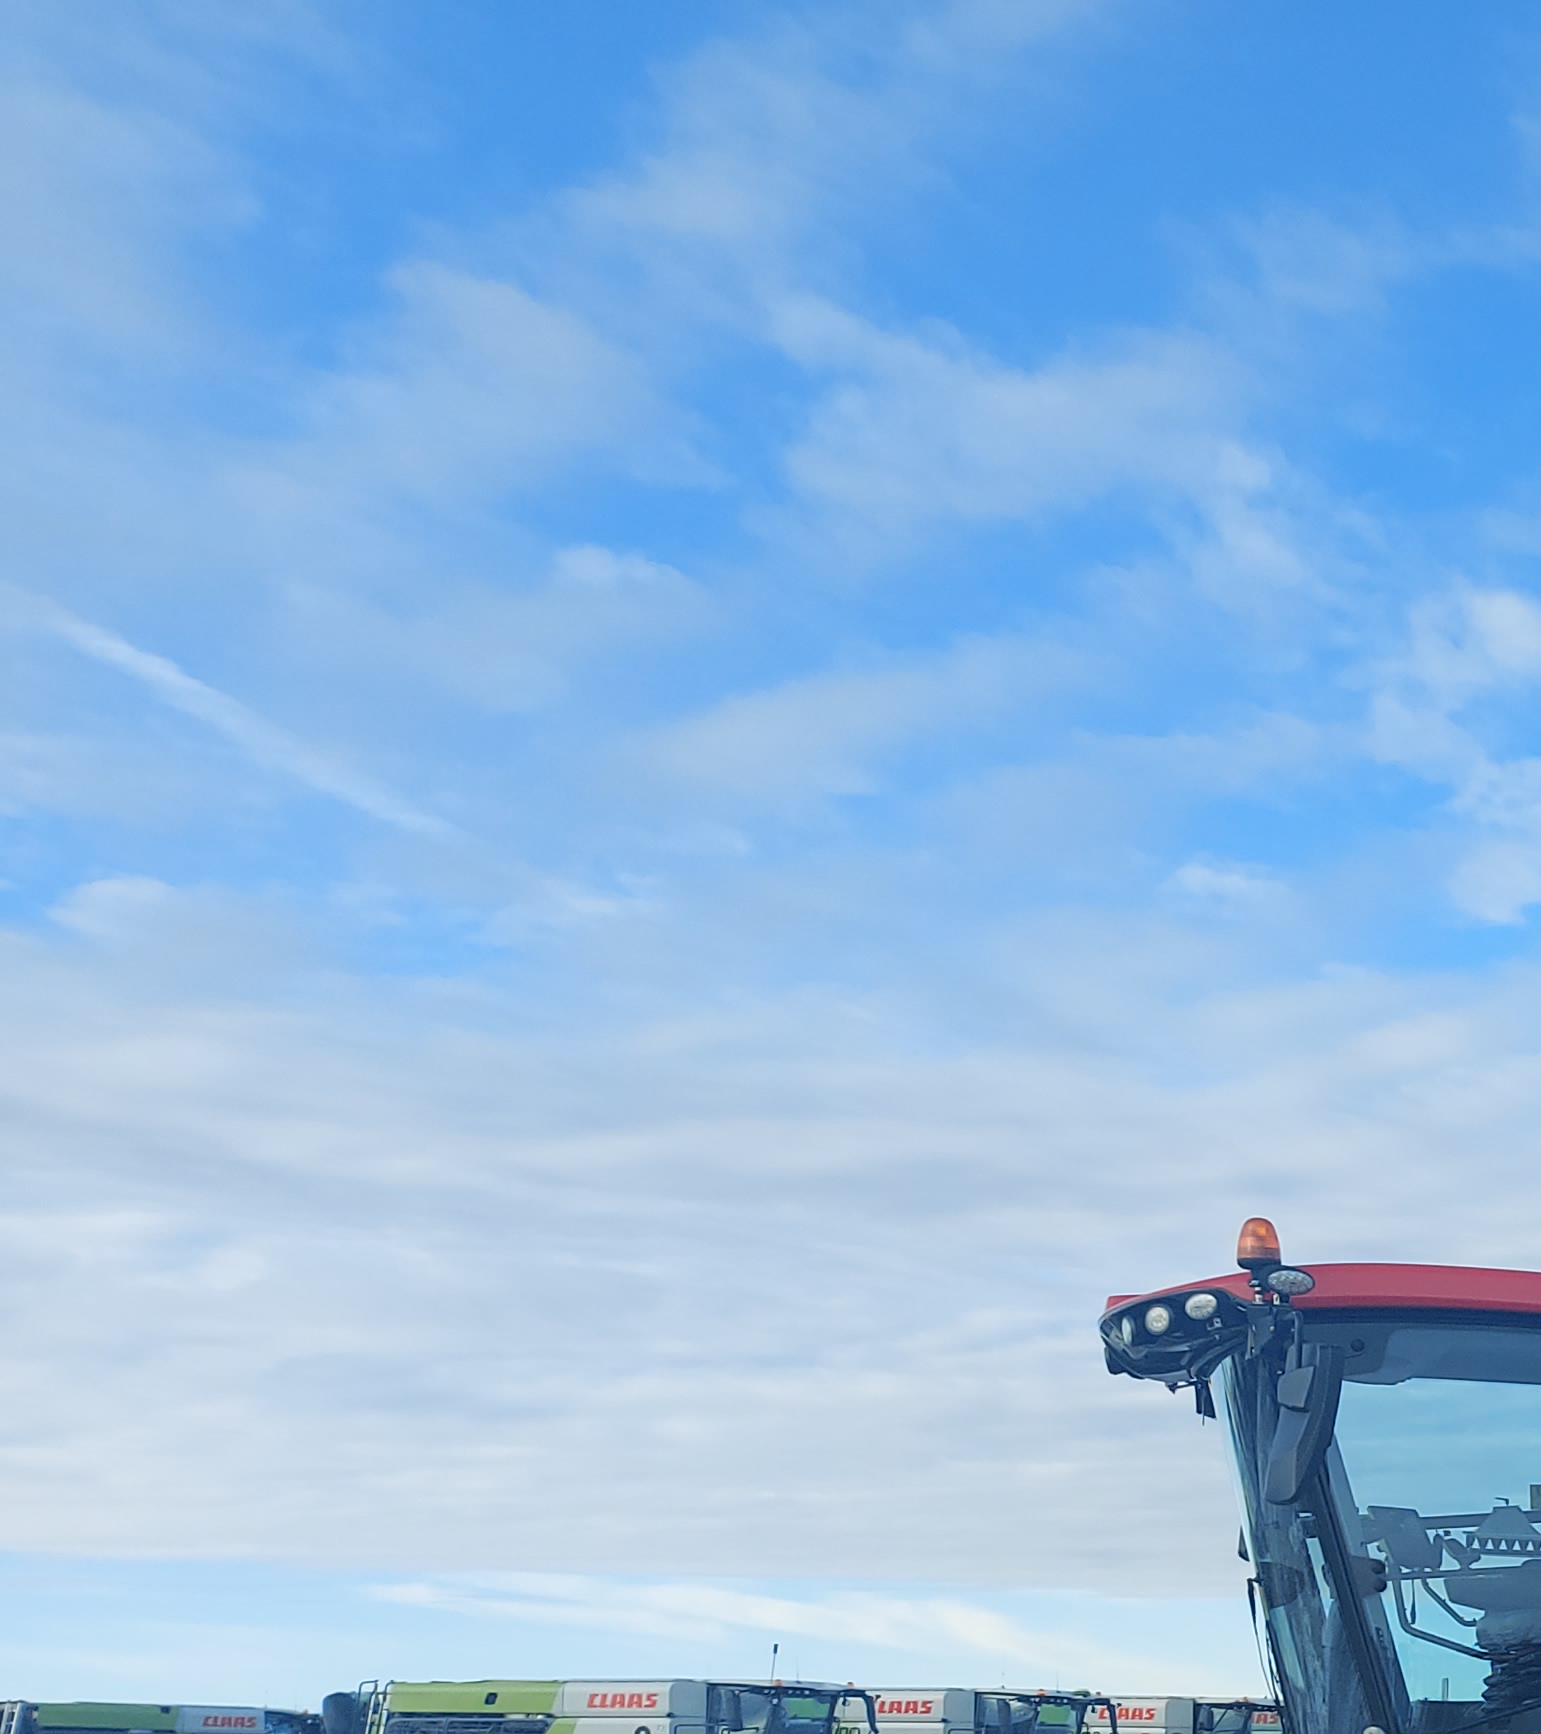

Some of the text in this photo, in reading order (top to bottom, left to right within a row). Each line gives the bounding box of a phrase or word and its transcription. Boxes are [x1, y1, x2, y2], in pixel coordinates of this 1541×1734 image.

[586, 1692, 659, 1708] CLAAS
[877, 1700, 934, 1714] LAAS
[1098, 1707, 1156, 1720] CAAS
[202, 1716, 257, 1728] CLAAS
